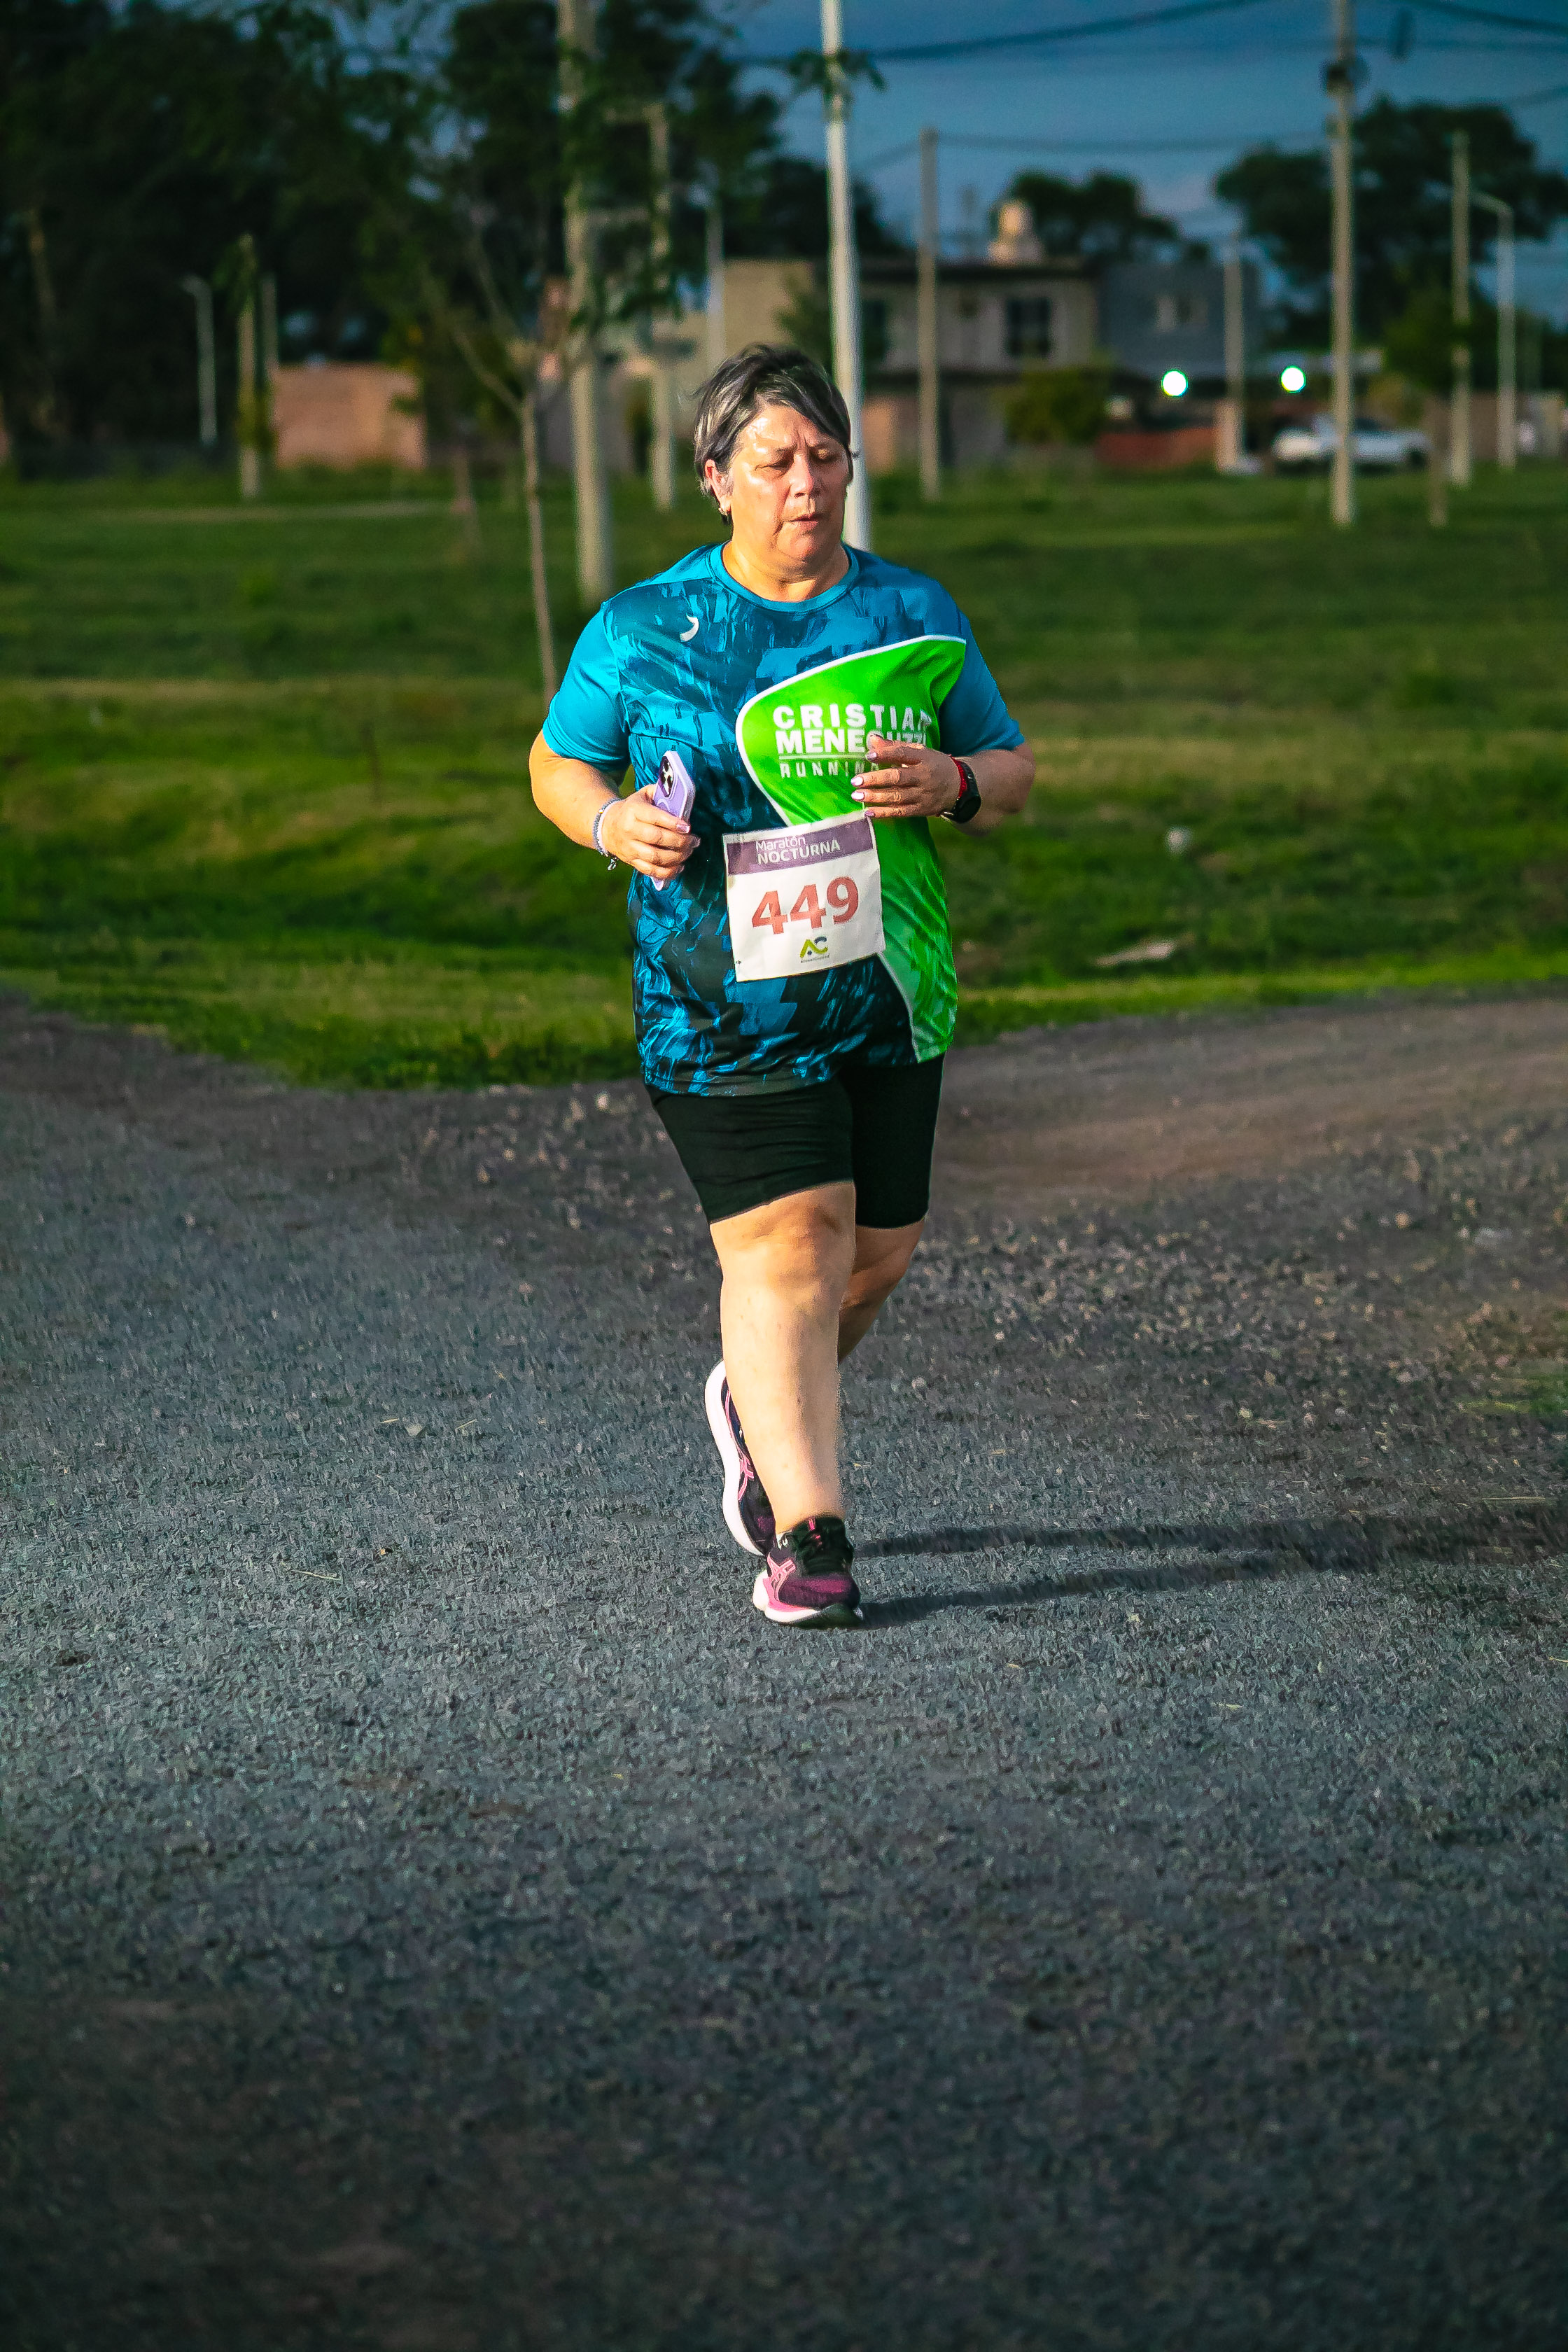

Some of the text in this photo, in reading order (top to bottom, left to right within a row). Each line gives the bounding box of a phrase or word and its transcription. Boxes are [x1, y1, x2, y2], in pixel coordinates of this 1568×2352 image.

[755, 835, 806, 852] Maratón
[757, 839, 841, 864] NOCTURNA
[751, 876, 859, 935] 449
